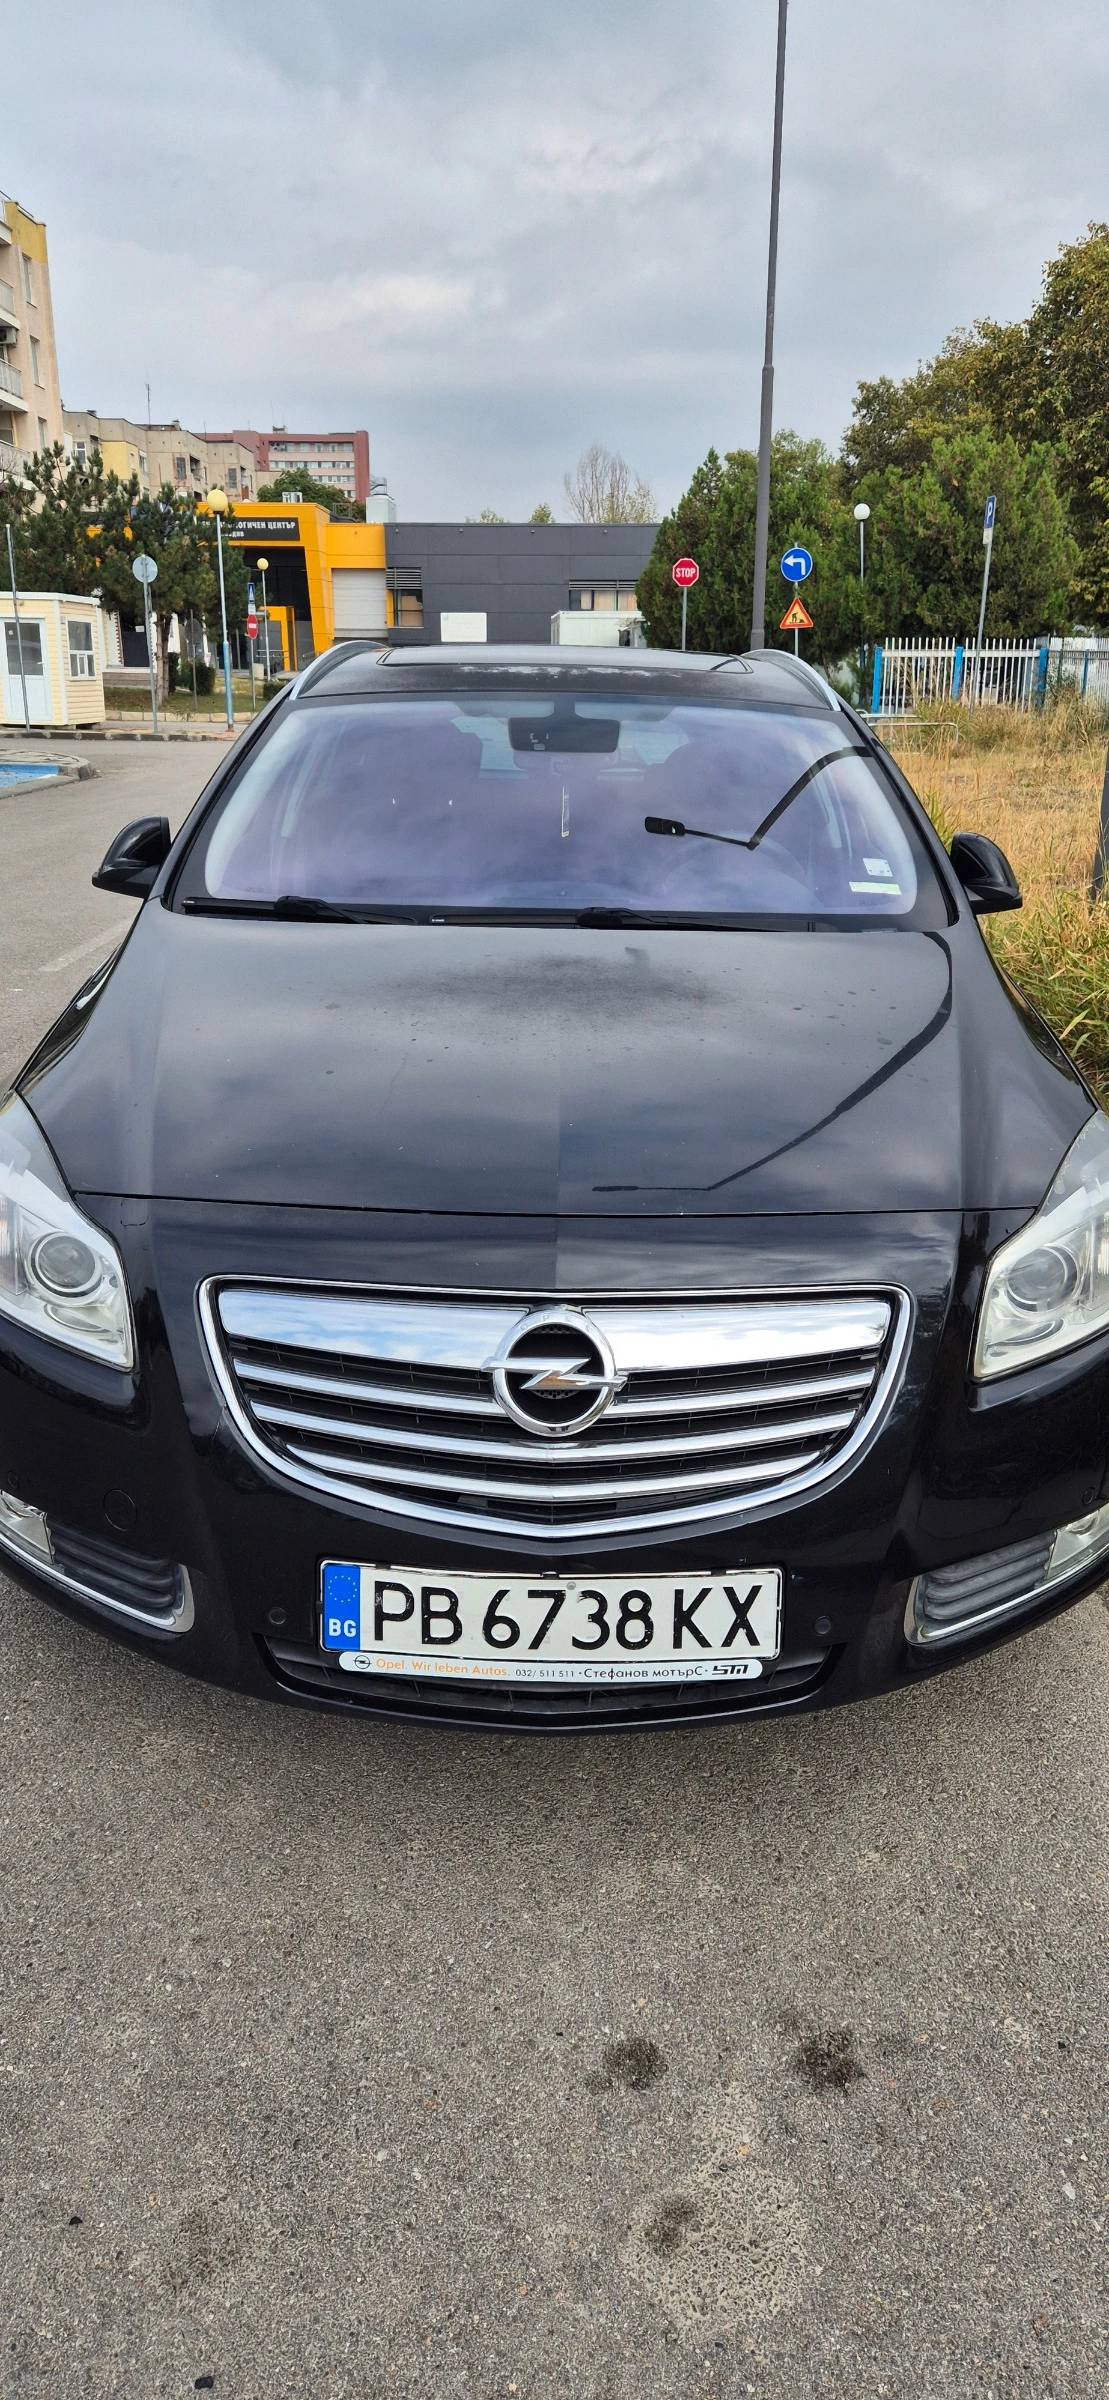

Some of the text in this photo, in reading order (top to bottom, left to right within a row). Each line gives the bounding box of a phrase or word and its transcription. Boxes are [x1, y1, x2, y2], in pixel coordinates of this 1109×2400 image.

[267, 521, 296, 530] ЦЕНТЪР
[675, 567, 696, 578] STOP
[374, 1580, 763, 1651] PB 6738 KX
[328, 1618, 357, 1638] BG
[375, 1658, 408, 1671] Opel.
[411, 1660, 431, 1672] Wir
[434, 1662, 469, 1674] leben
[472, 1665, 510, 1677] Autos.
